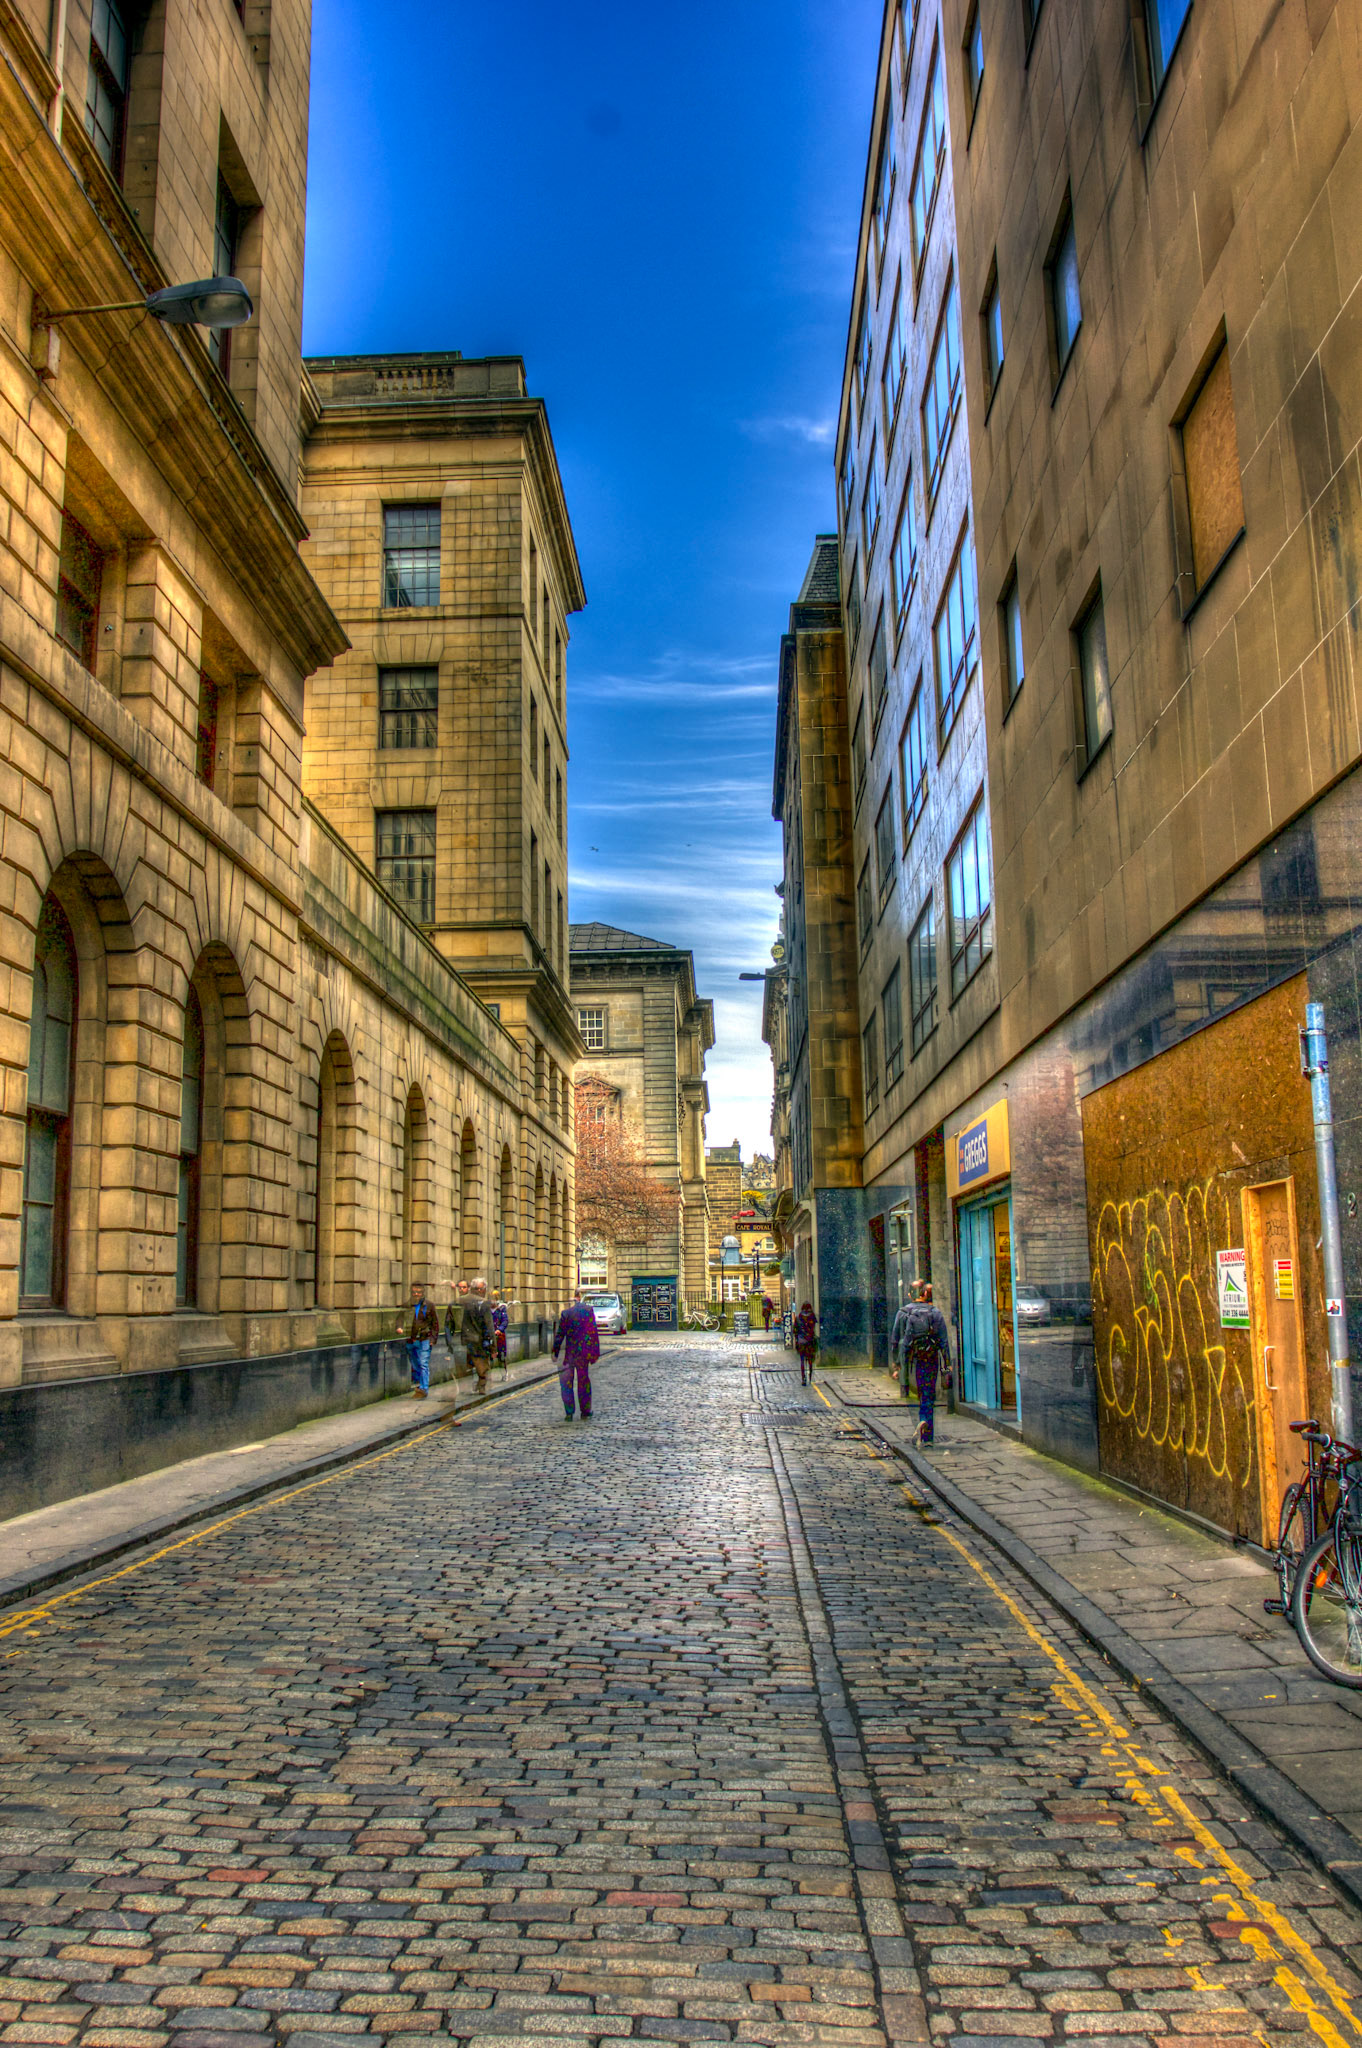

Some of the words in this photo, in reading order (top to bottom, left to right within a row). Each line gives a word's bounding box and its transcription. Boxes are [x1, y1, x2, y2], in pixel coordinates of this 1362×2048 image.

[964, 1131, 987, 1173] GREGGS
[1346, 1192, 1358, 1218] 2
[1219, 1250, 1246, 1263] WARNING
[1223, 1293, 1240, 1303] ATRIUM
